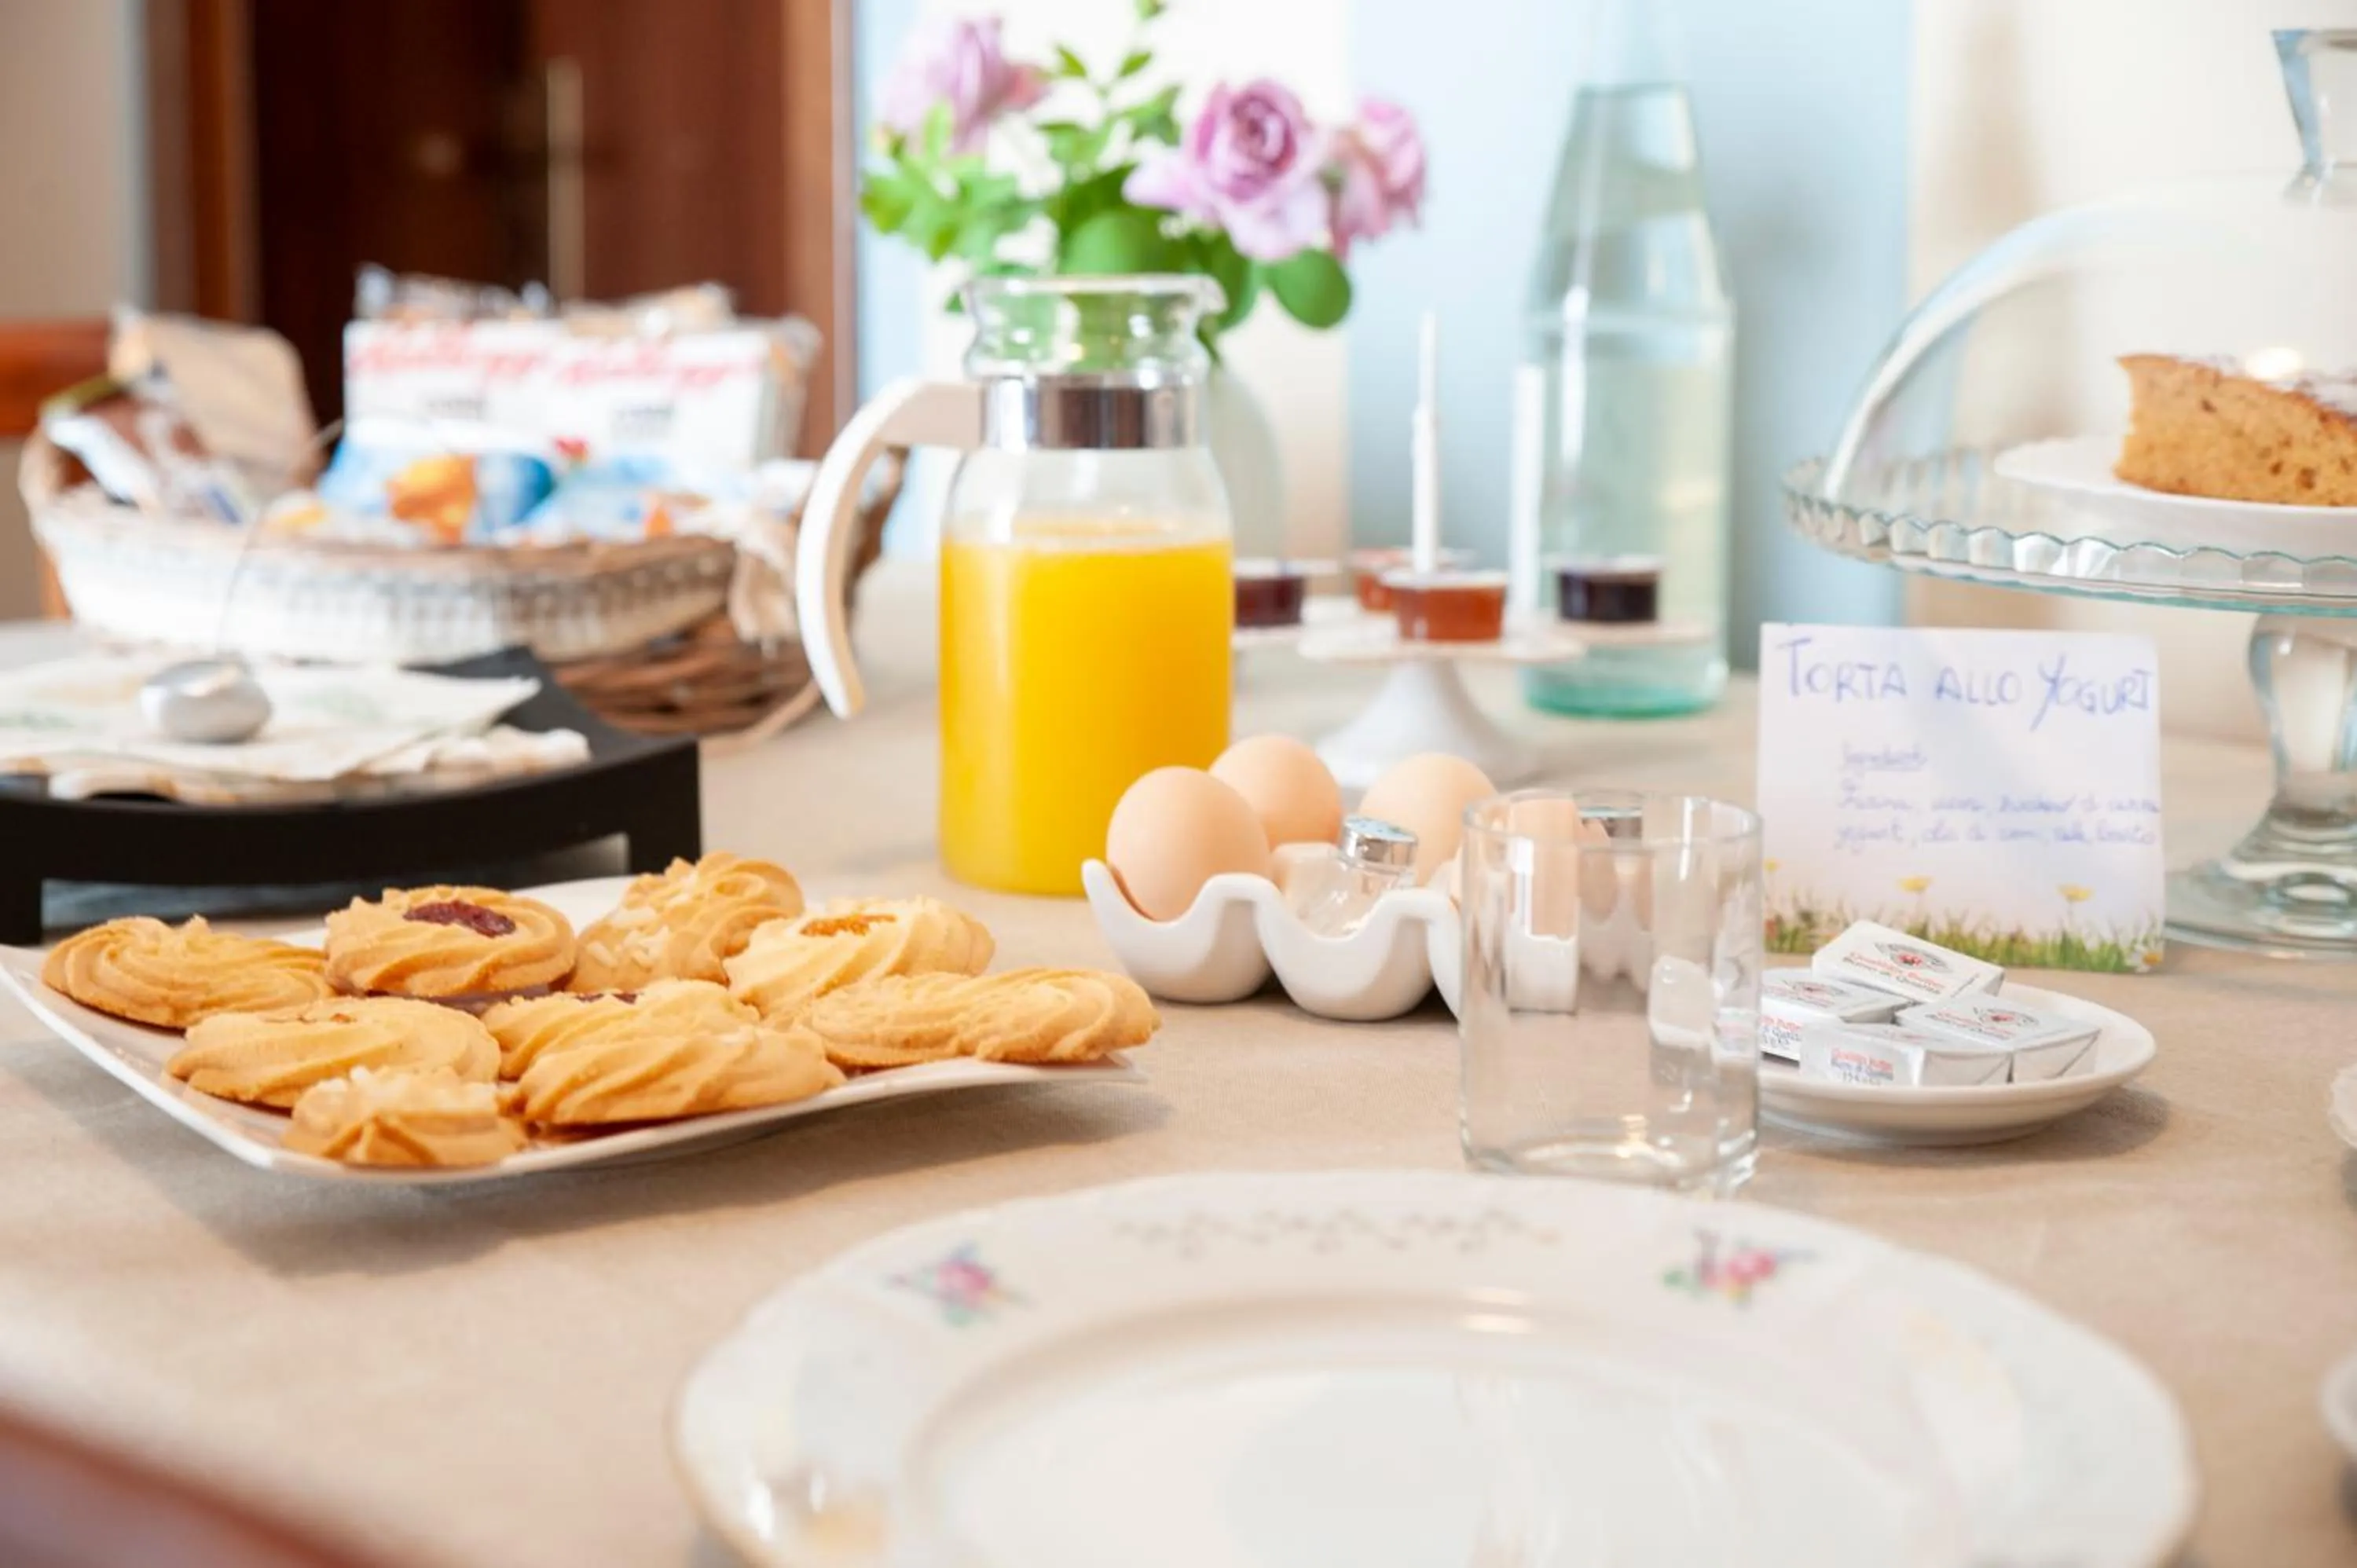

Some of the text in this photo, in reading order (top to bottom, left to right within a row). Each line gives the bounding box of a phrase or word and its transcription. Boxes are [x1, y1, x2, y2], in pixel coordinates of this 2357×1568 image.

[1776, 636, 2154, 733] TORTA ALLO YOGURT
